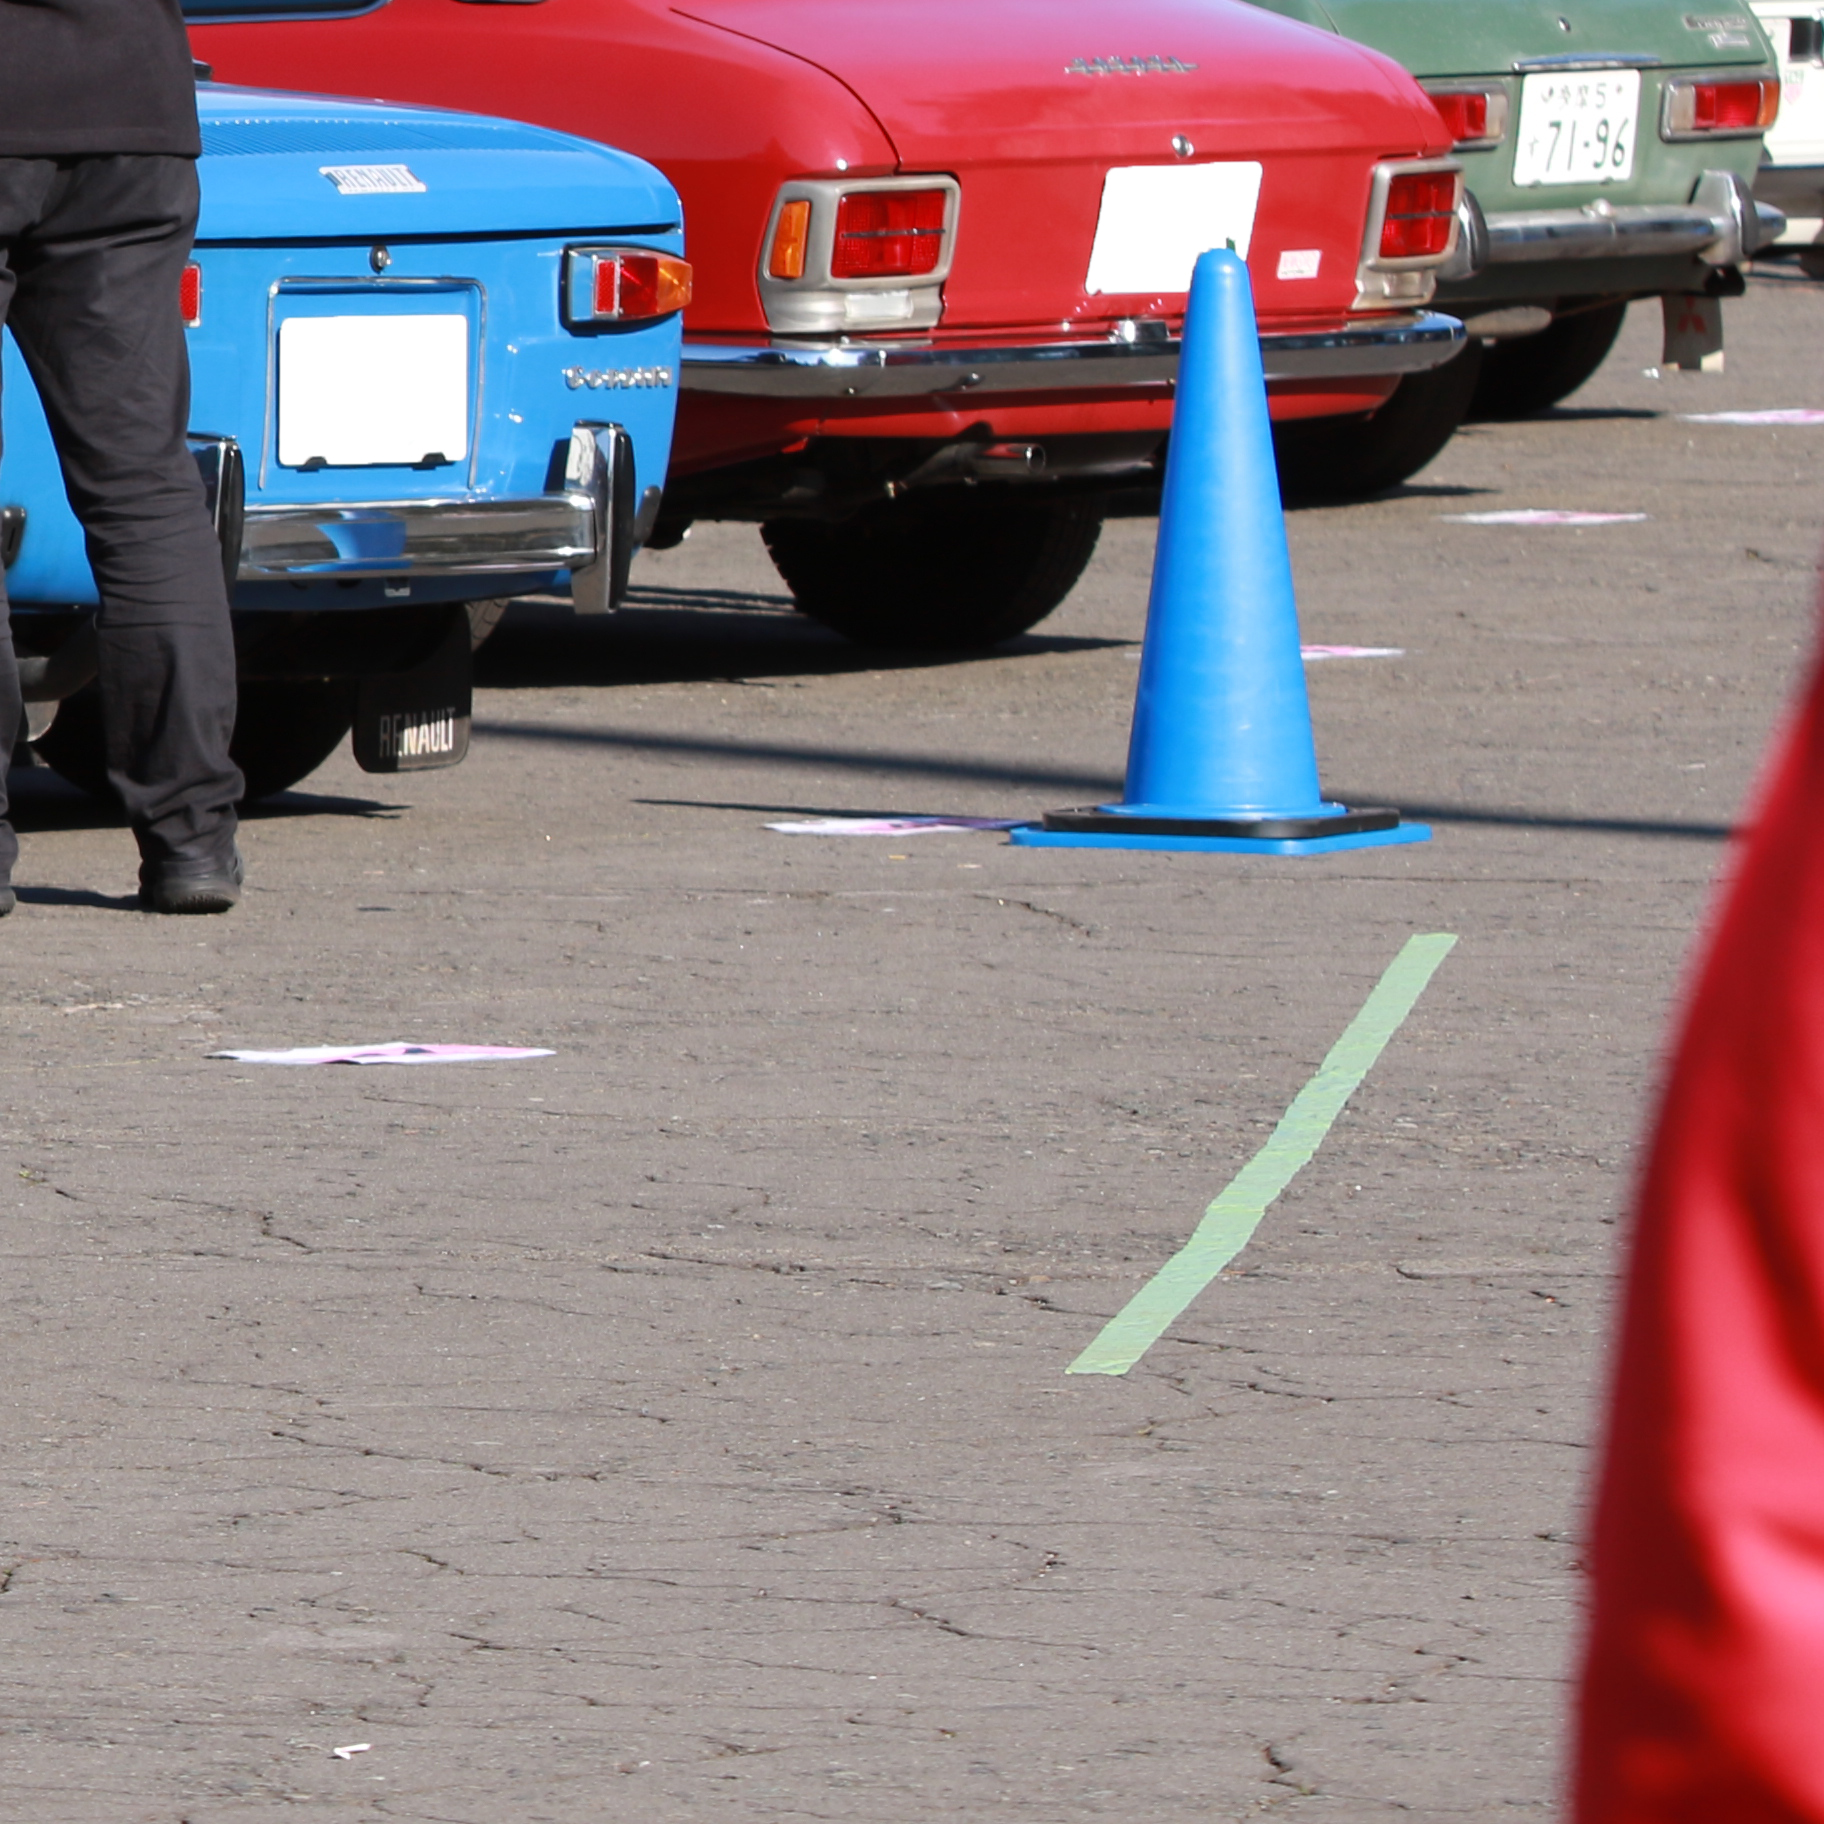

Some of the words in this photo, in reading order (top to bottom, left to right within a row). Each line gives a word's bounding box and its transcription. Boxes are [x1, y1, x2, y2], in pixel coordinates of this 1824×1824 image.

[1546, 117, 1629, 172] 71-96
[333, 167, 415, 188] RENAULT
[379, 707, 455, 758] RENAULT
